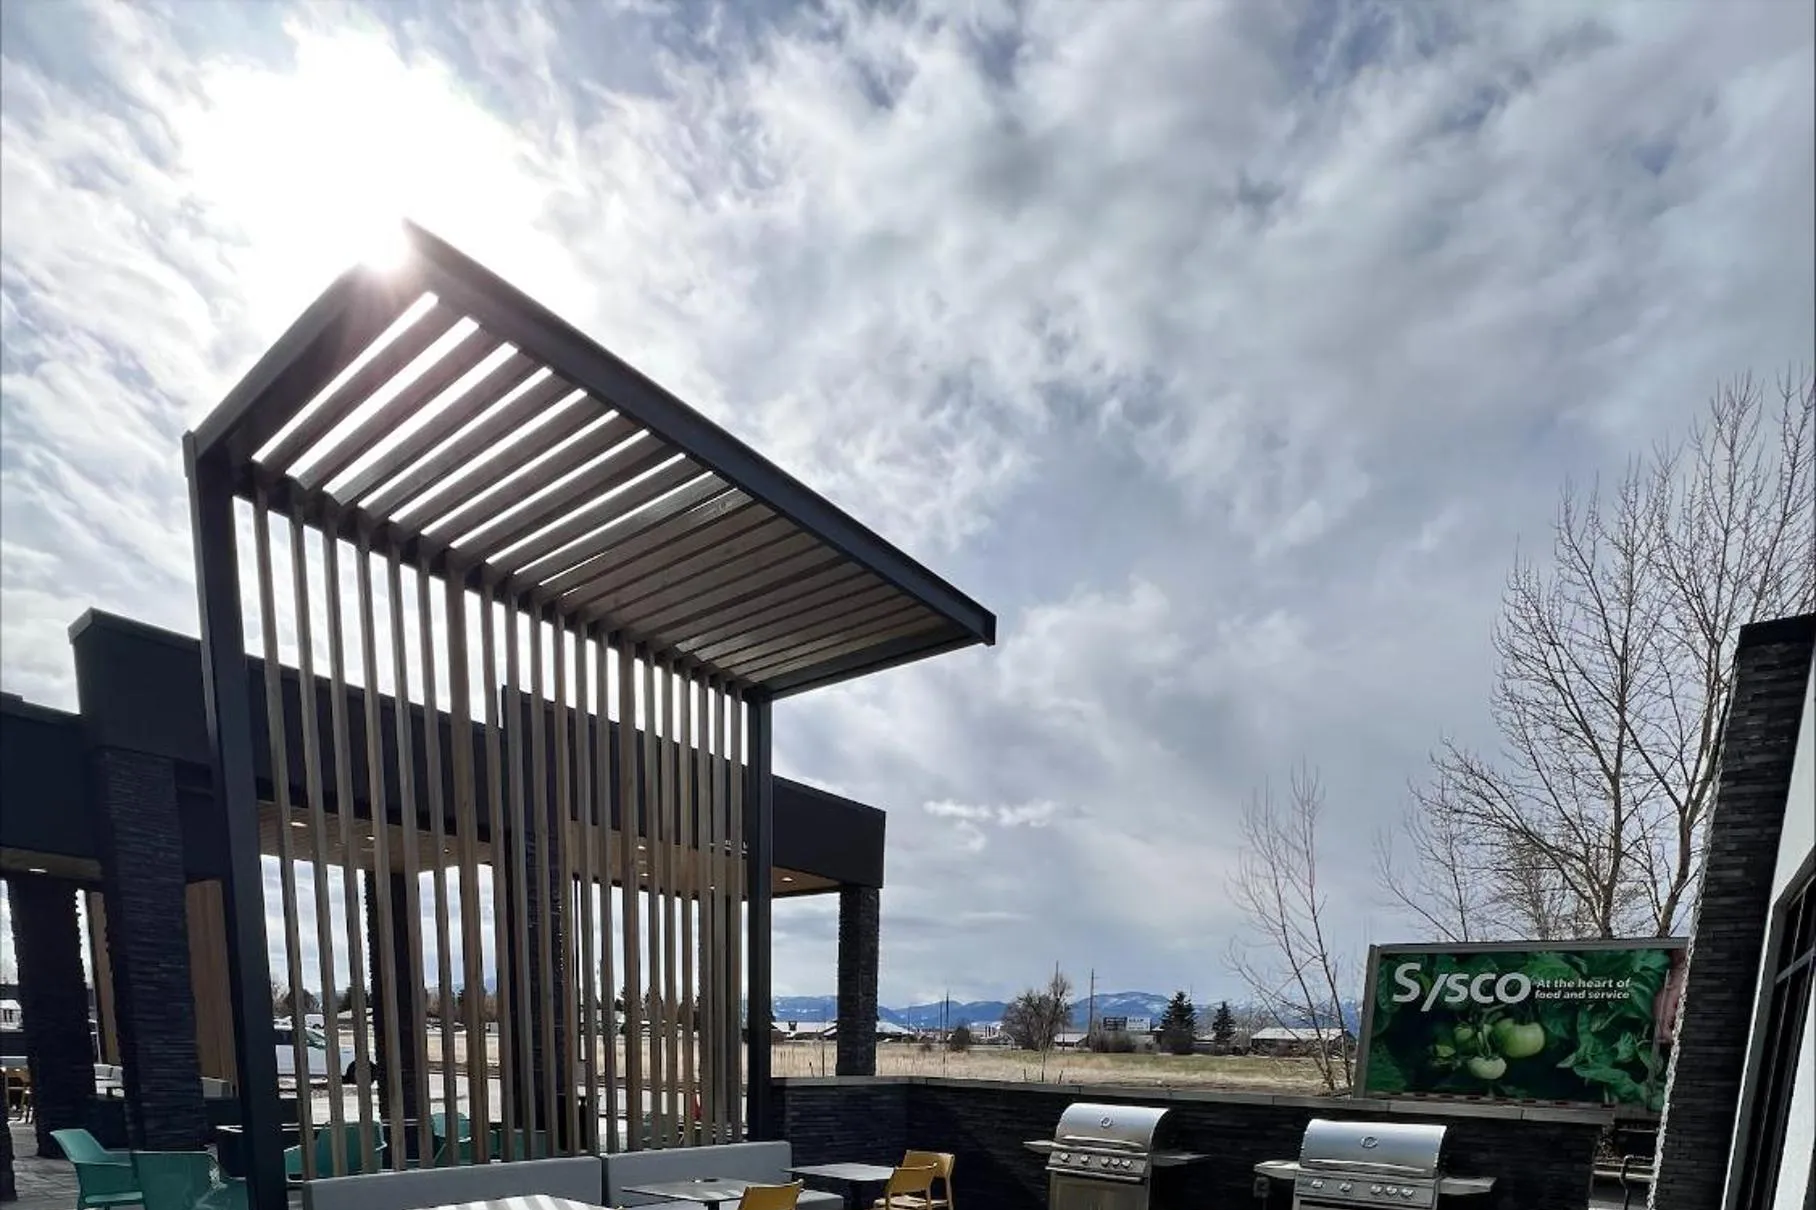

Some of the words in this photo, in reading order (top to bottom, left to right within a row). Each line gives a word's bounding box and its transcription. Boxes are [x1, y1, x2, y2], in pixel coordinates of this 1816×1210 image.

[1536, 979, 1551, 988] At
[1554, 978, 1575, 988] the
[1578, 978, 1613, 988] heart
[1616, 977, 1631, 988] of
[1535, 989, 1561, 999] food
[1563, 989, 1586, 999] and
[1587, 989, 1630, 999] service
